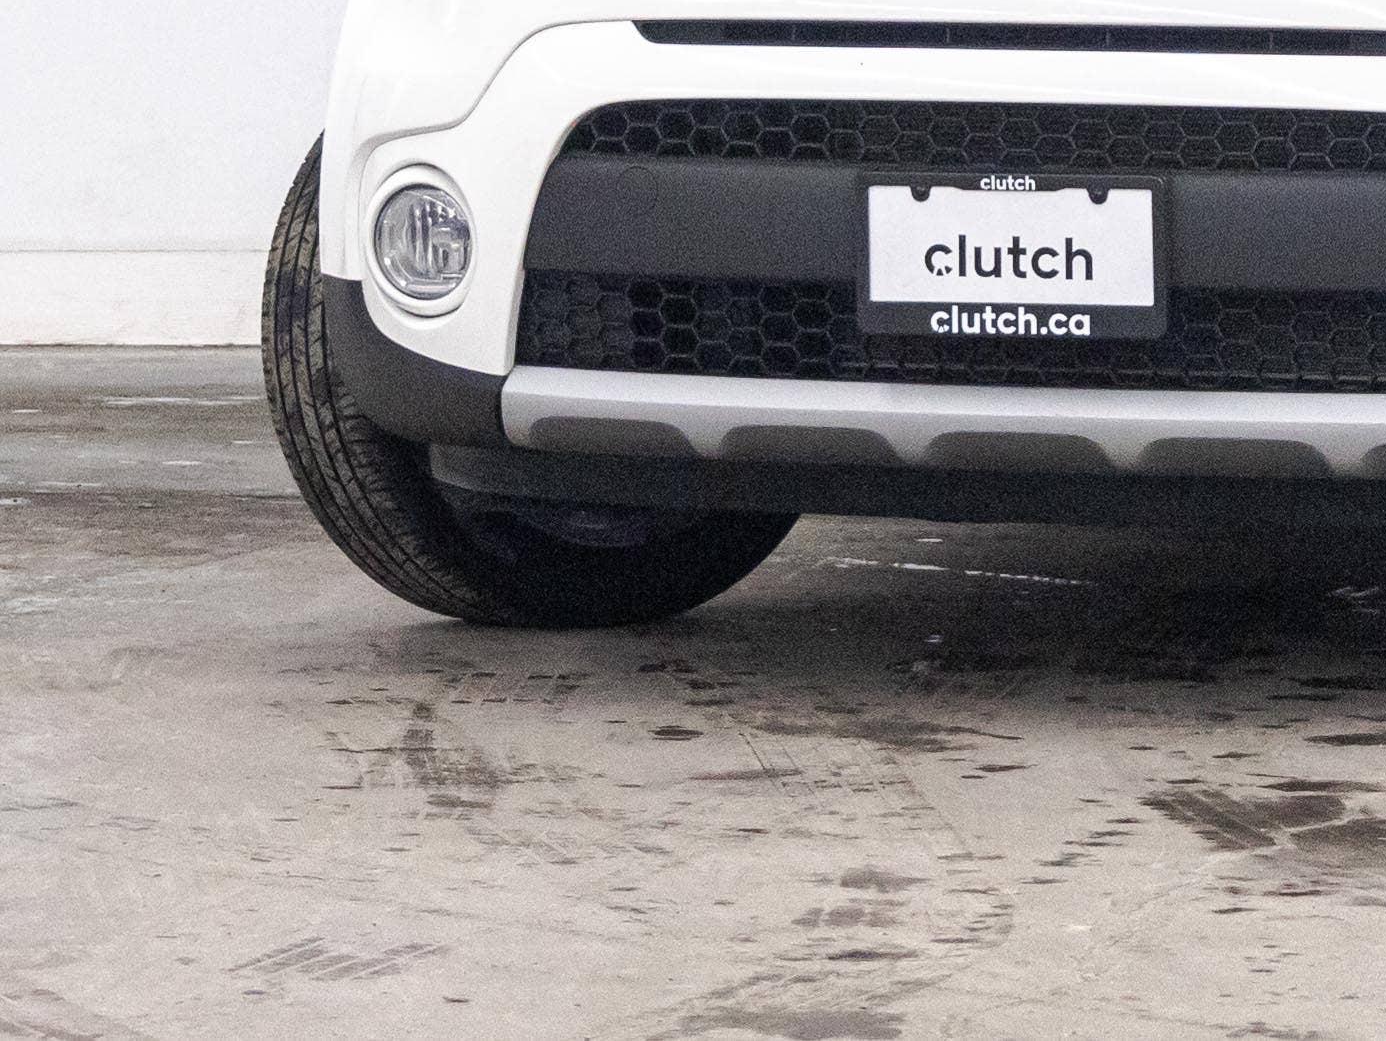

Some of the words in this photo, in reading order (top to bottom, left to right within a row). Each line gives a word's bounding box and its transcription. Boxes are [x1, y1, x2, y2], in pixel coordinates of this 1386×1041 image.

[980, 175, 1036, 191] clutch
[924, 234, 1094, 281] clutch
[930, 305, 1091, 336] clutch.ca
